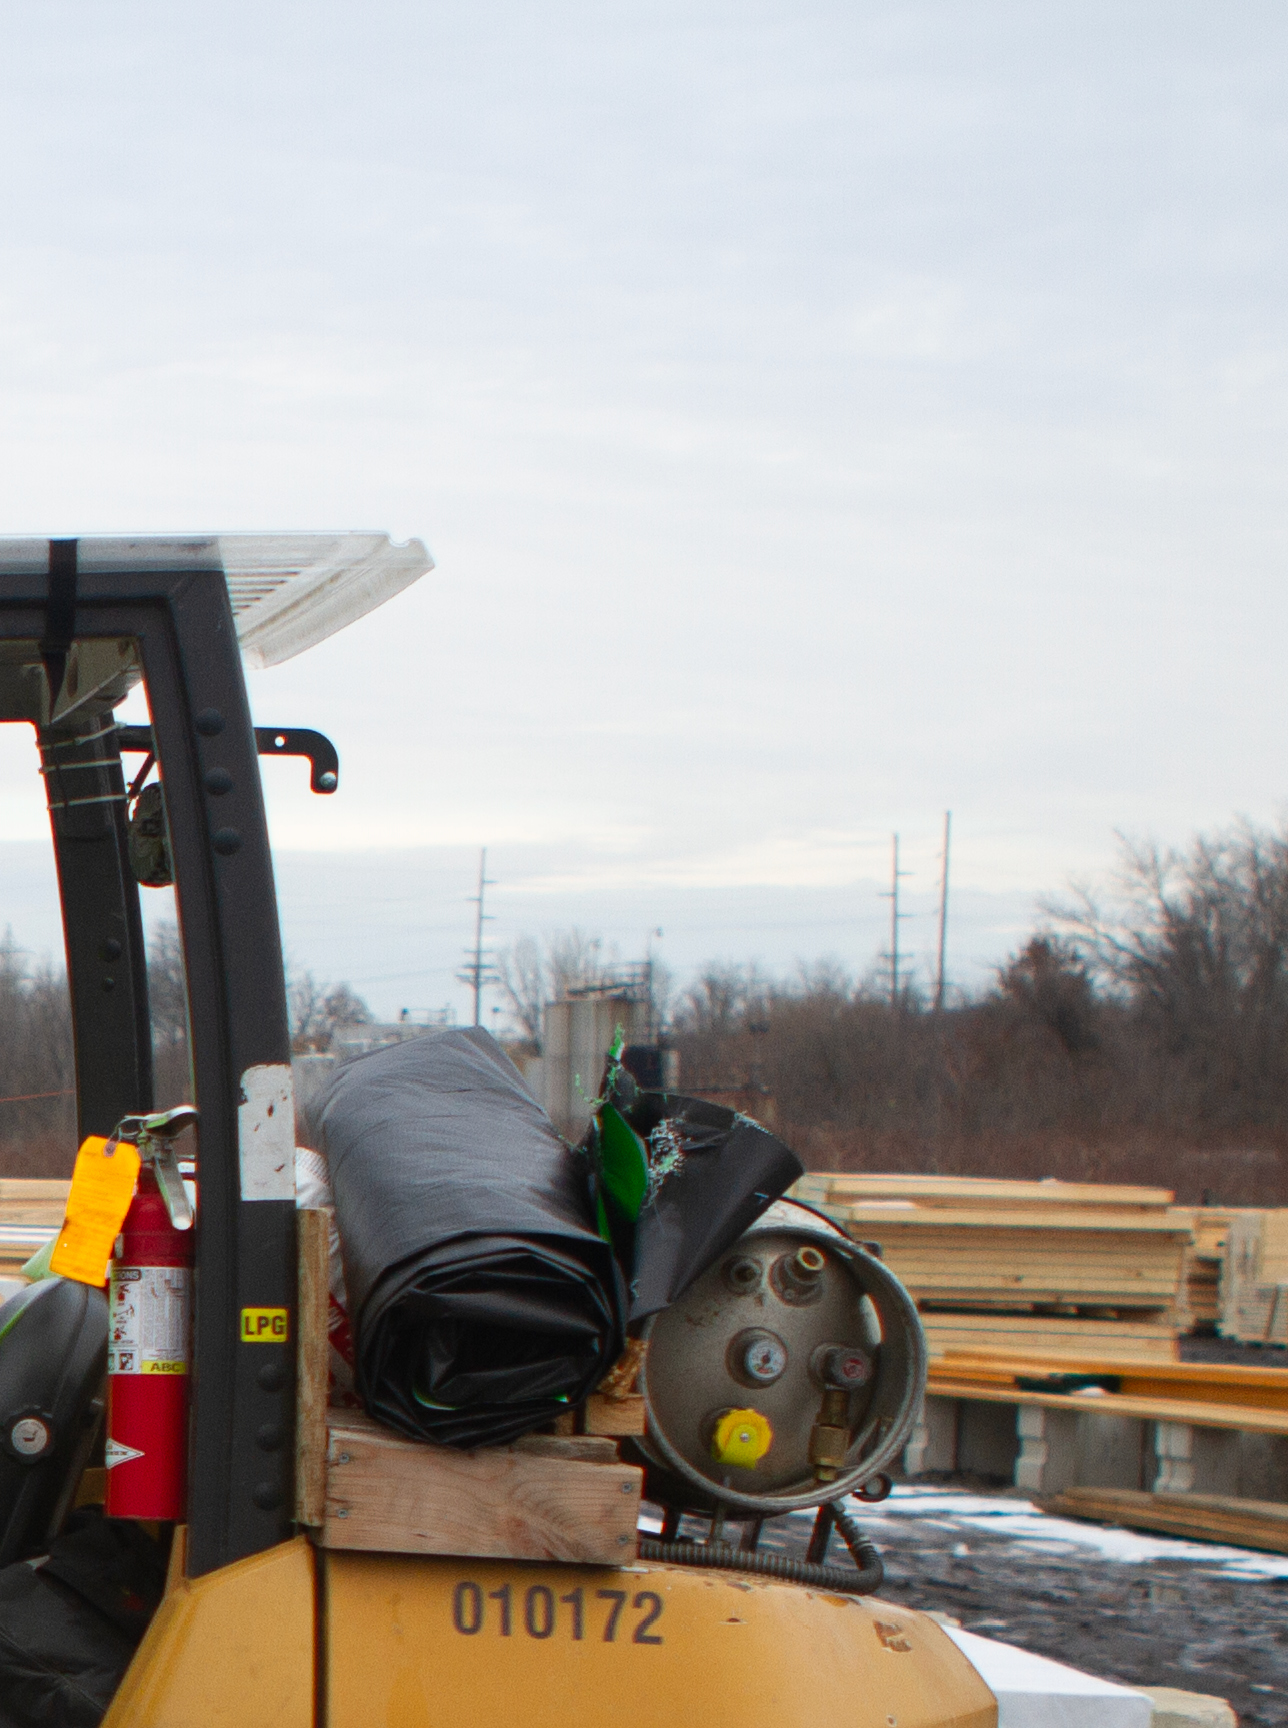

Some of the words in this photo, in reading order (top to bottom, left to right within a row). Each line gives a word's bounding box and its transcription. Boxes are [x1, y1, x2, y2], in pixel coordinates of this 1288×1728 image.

[243, 1313, 287, 1337] LPG
[150, 1362, 181, 1372] ABC
[452, 1581, 664, 1646] 010172
